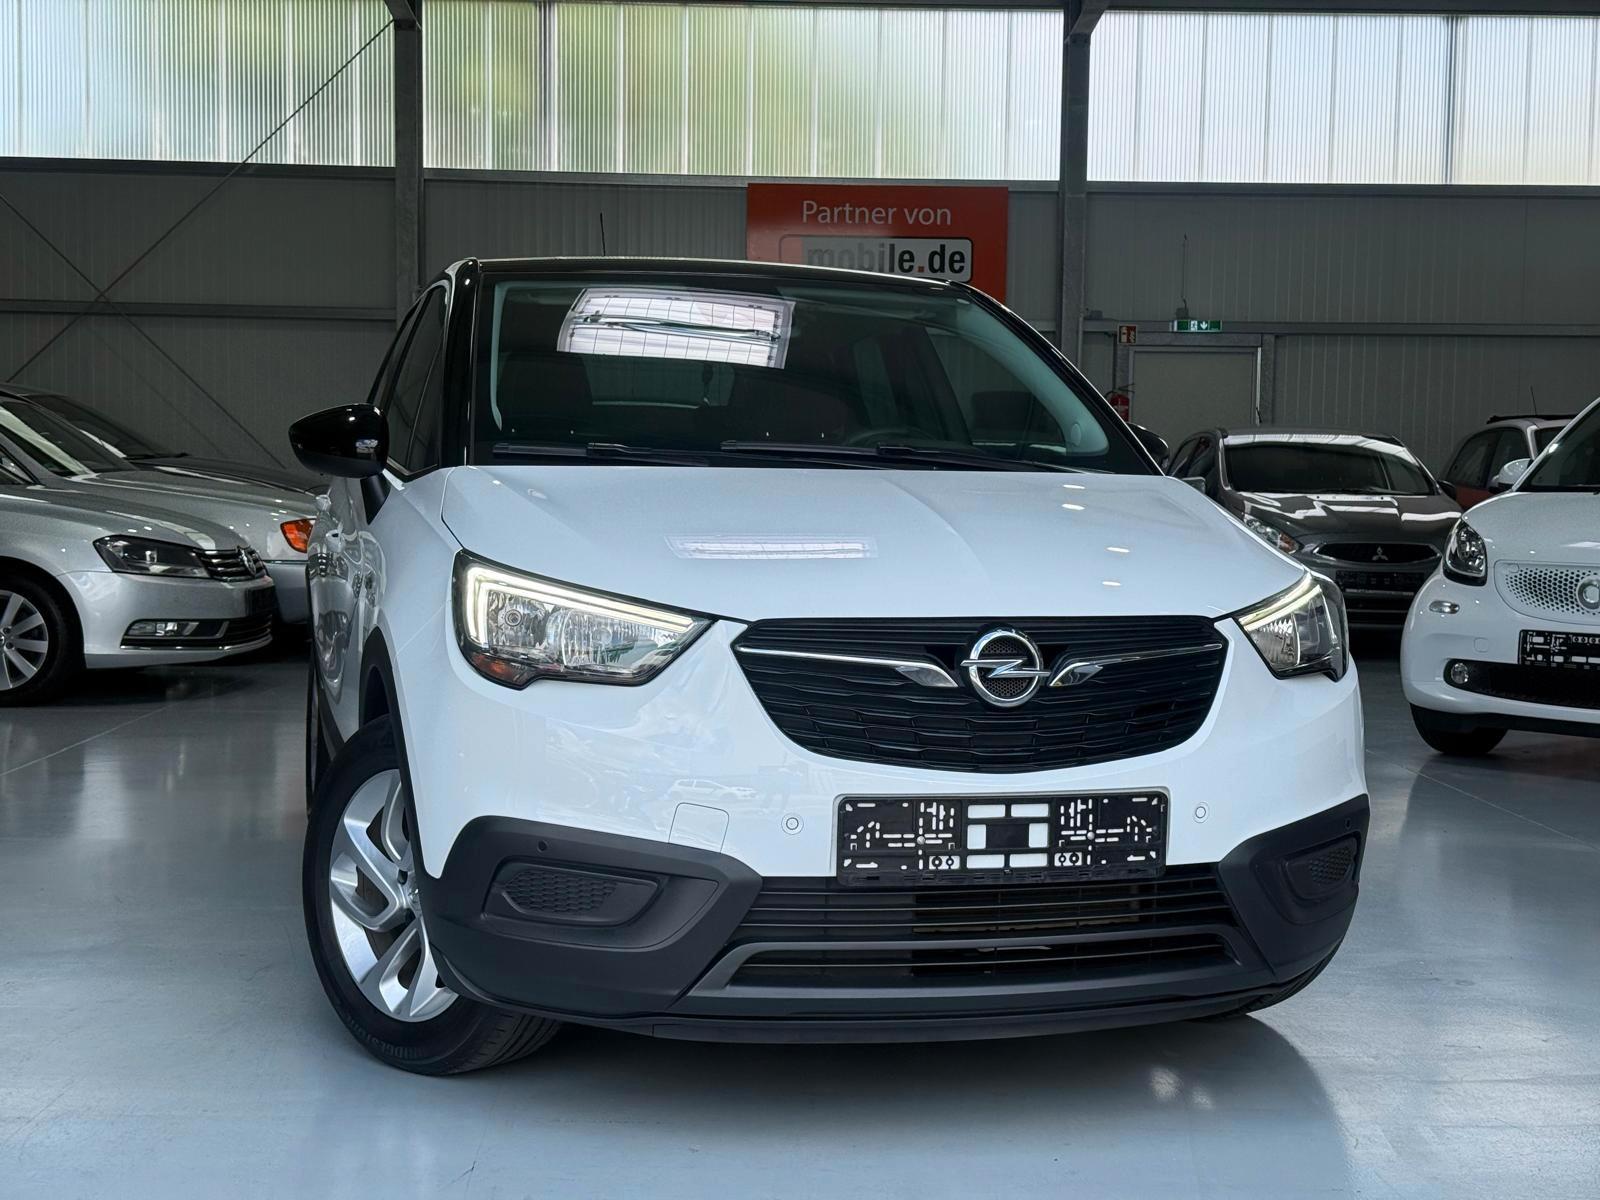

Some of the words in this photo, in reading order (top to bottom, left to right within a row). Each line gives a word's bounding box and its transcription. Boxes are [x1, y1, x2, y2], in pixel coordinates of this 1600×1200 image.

[802, 200, 897, 225] Partner
[903, 207, 952, 226] von
[807, 243, 966, 274] mobile.de
